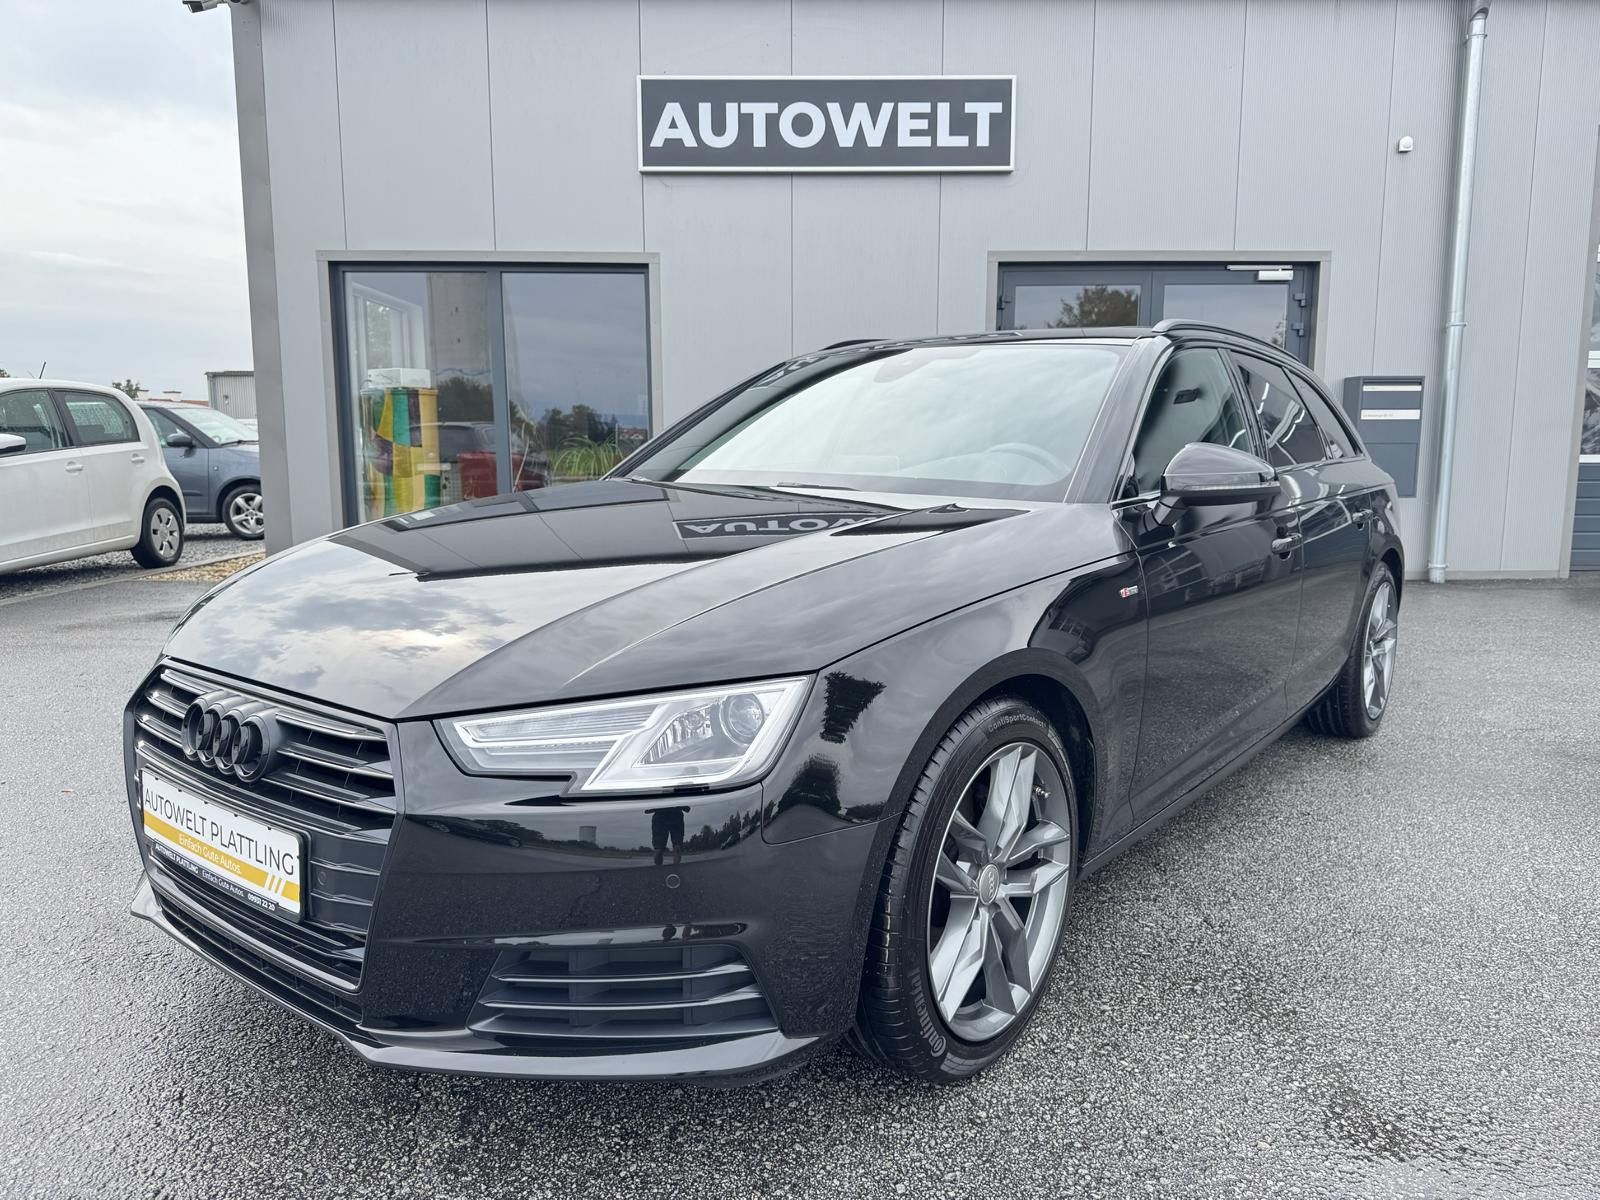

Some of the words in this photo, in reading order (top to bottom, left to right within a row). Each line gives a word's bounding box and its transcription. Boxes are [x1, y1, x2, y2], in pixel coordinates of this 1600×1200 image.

[650, 102, 1002, 148] AUTOWELT
[144, 788, 206, 837] AUTOWELT
[210, 821, 294, 876] PLATTLING
[178, 833, 202, 853] Einfach
[202, 846, 220, 864] Gute
[176, 855, 198, 874] PLATTLING
